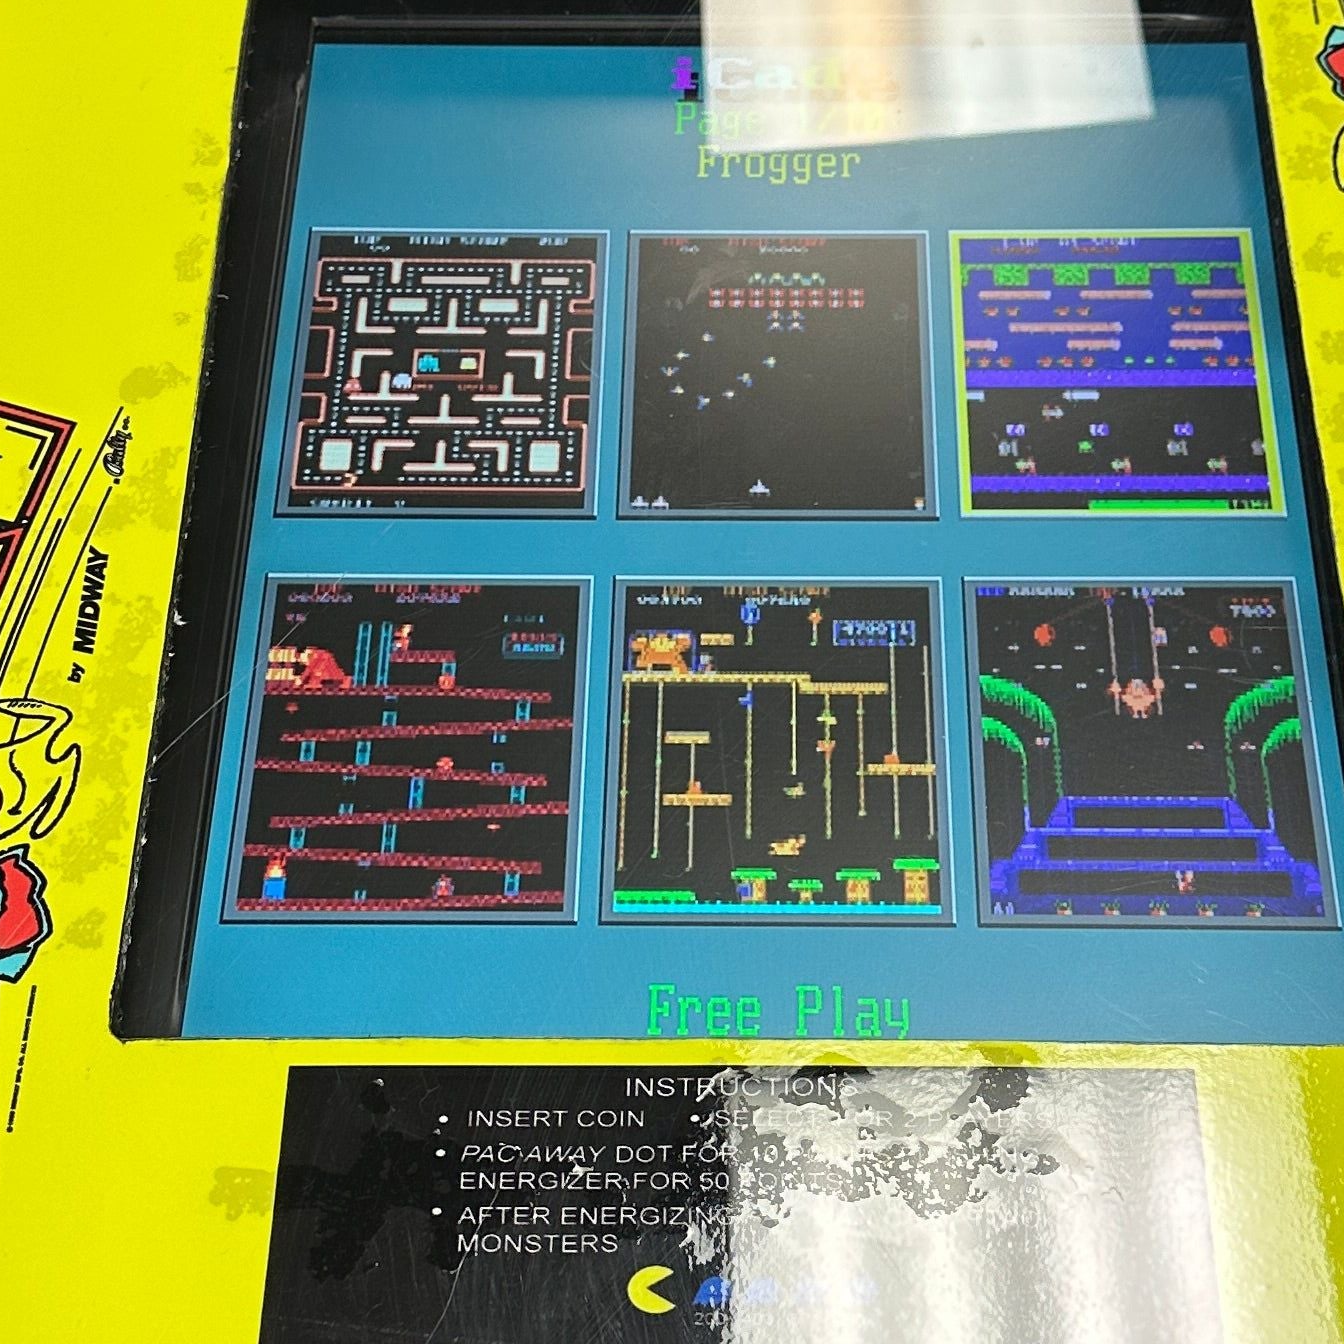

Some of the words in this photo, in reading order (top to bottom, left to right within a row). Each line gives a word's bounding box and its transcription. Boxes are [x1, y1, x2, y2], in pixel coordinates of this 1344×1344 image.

[697, 144, 861, 185] Frogger
[72, 545, 109, 655] MIDWAY
[67, 662, 86, 683] by
[647, 982, 762, 1037] Free
[794, 984, 910, 1039] Play
[626, 1076, 859, 1097] INSTRUCTIONS
[467, 1110, 569, 1128] INSERT
[577, 1110, 645, 1128] COIN
[616, 1145, 676, 1163] DOT
[682, 1144, 739, 1164] FOR
[460, 1172, 623, 1190] ENERGIZER
[633, 1172, 690, 1190] FOR
[699, 1172, 730, 1190] 50
[458, 1207, 551, 1225] AFTER
[560, 1207, 735, 1226] ENERGIZING
[457, 1234, 619, 1253] MONSTERS
